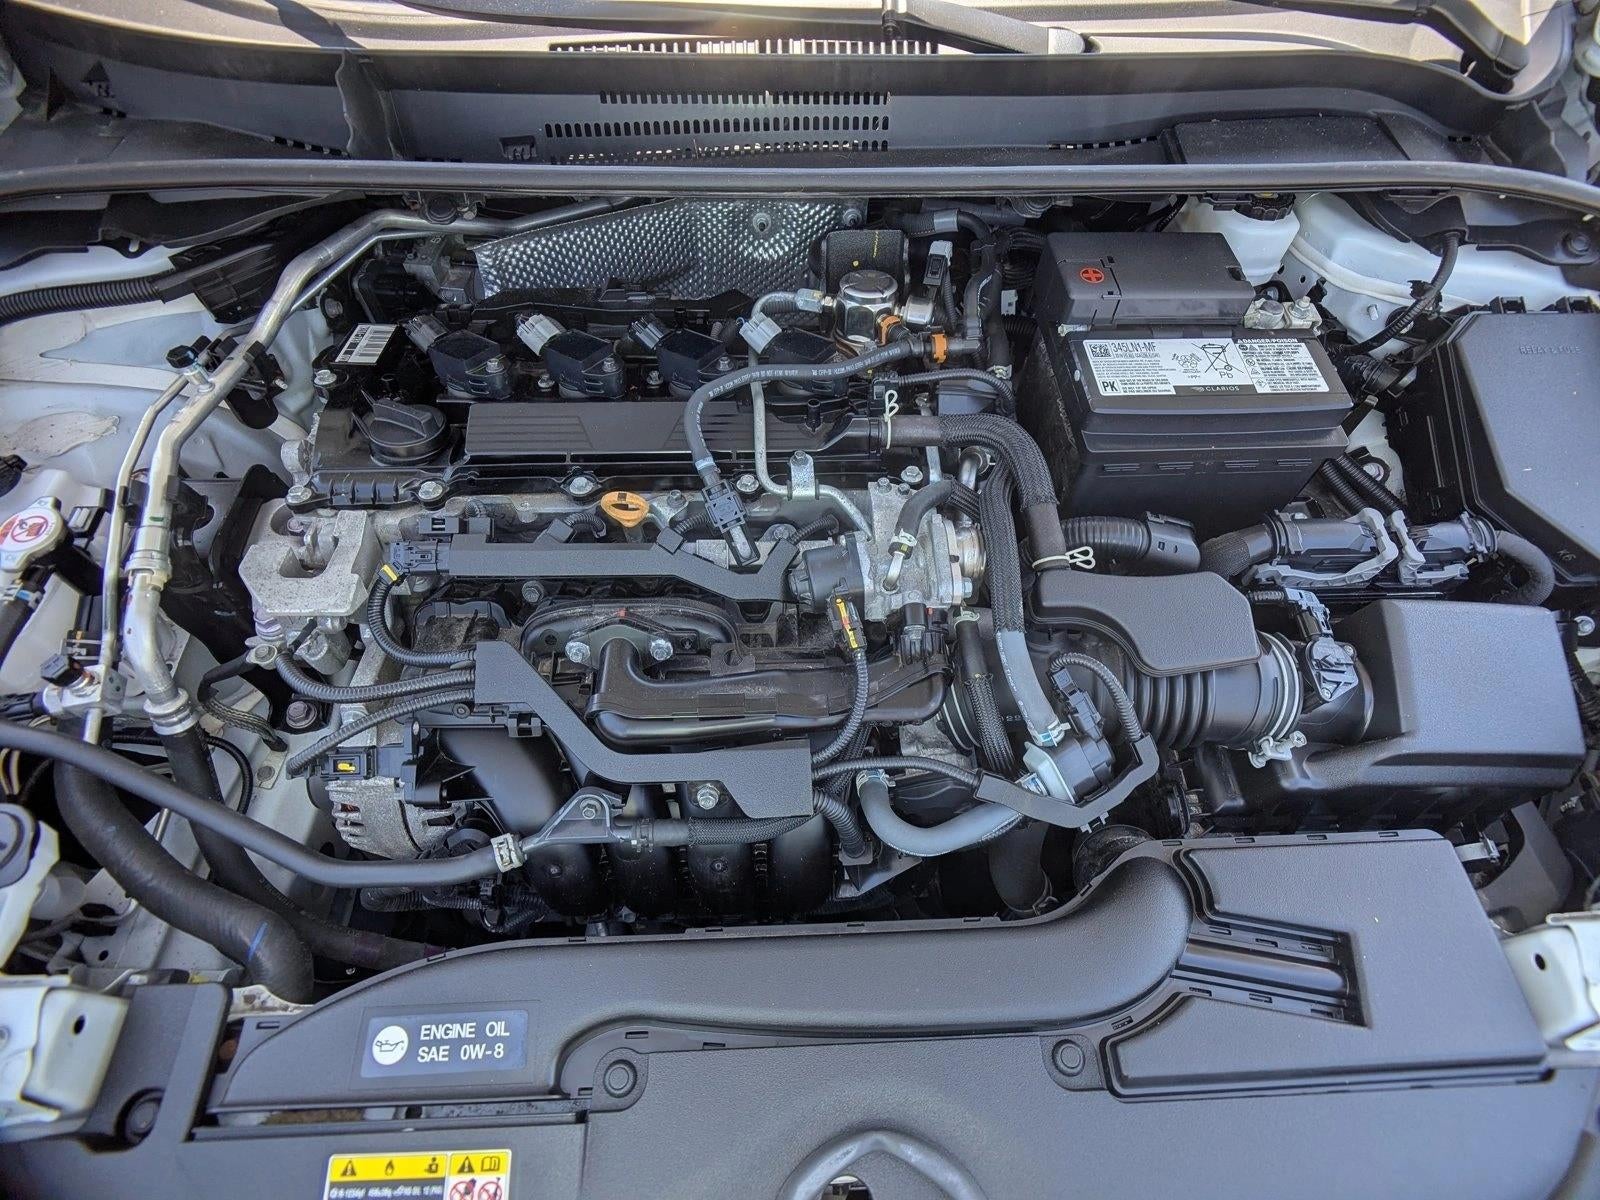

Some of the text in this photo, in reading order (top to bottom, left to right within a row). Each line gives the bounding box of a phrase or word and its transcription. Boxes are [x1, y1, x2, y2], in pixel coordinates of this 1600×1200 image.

[1111, 342, 1156, 352] 345LN1-MF
[1102, 381, 1118, 392] PK
[420, 1021, 510, 1041] ENGINE OIL
[417, 1042, 504, 1063] SAE 0W-8
